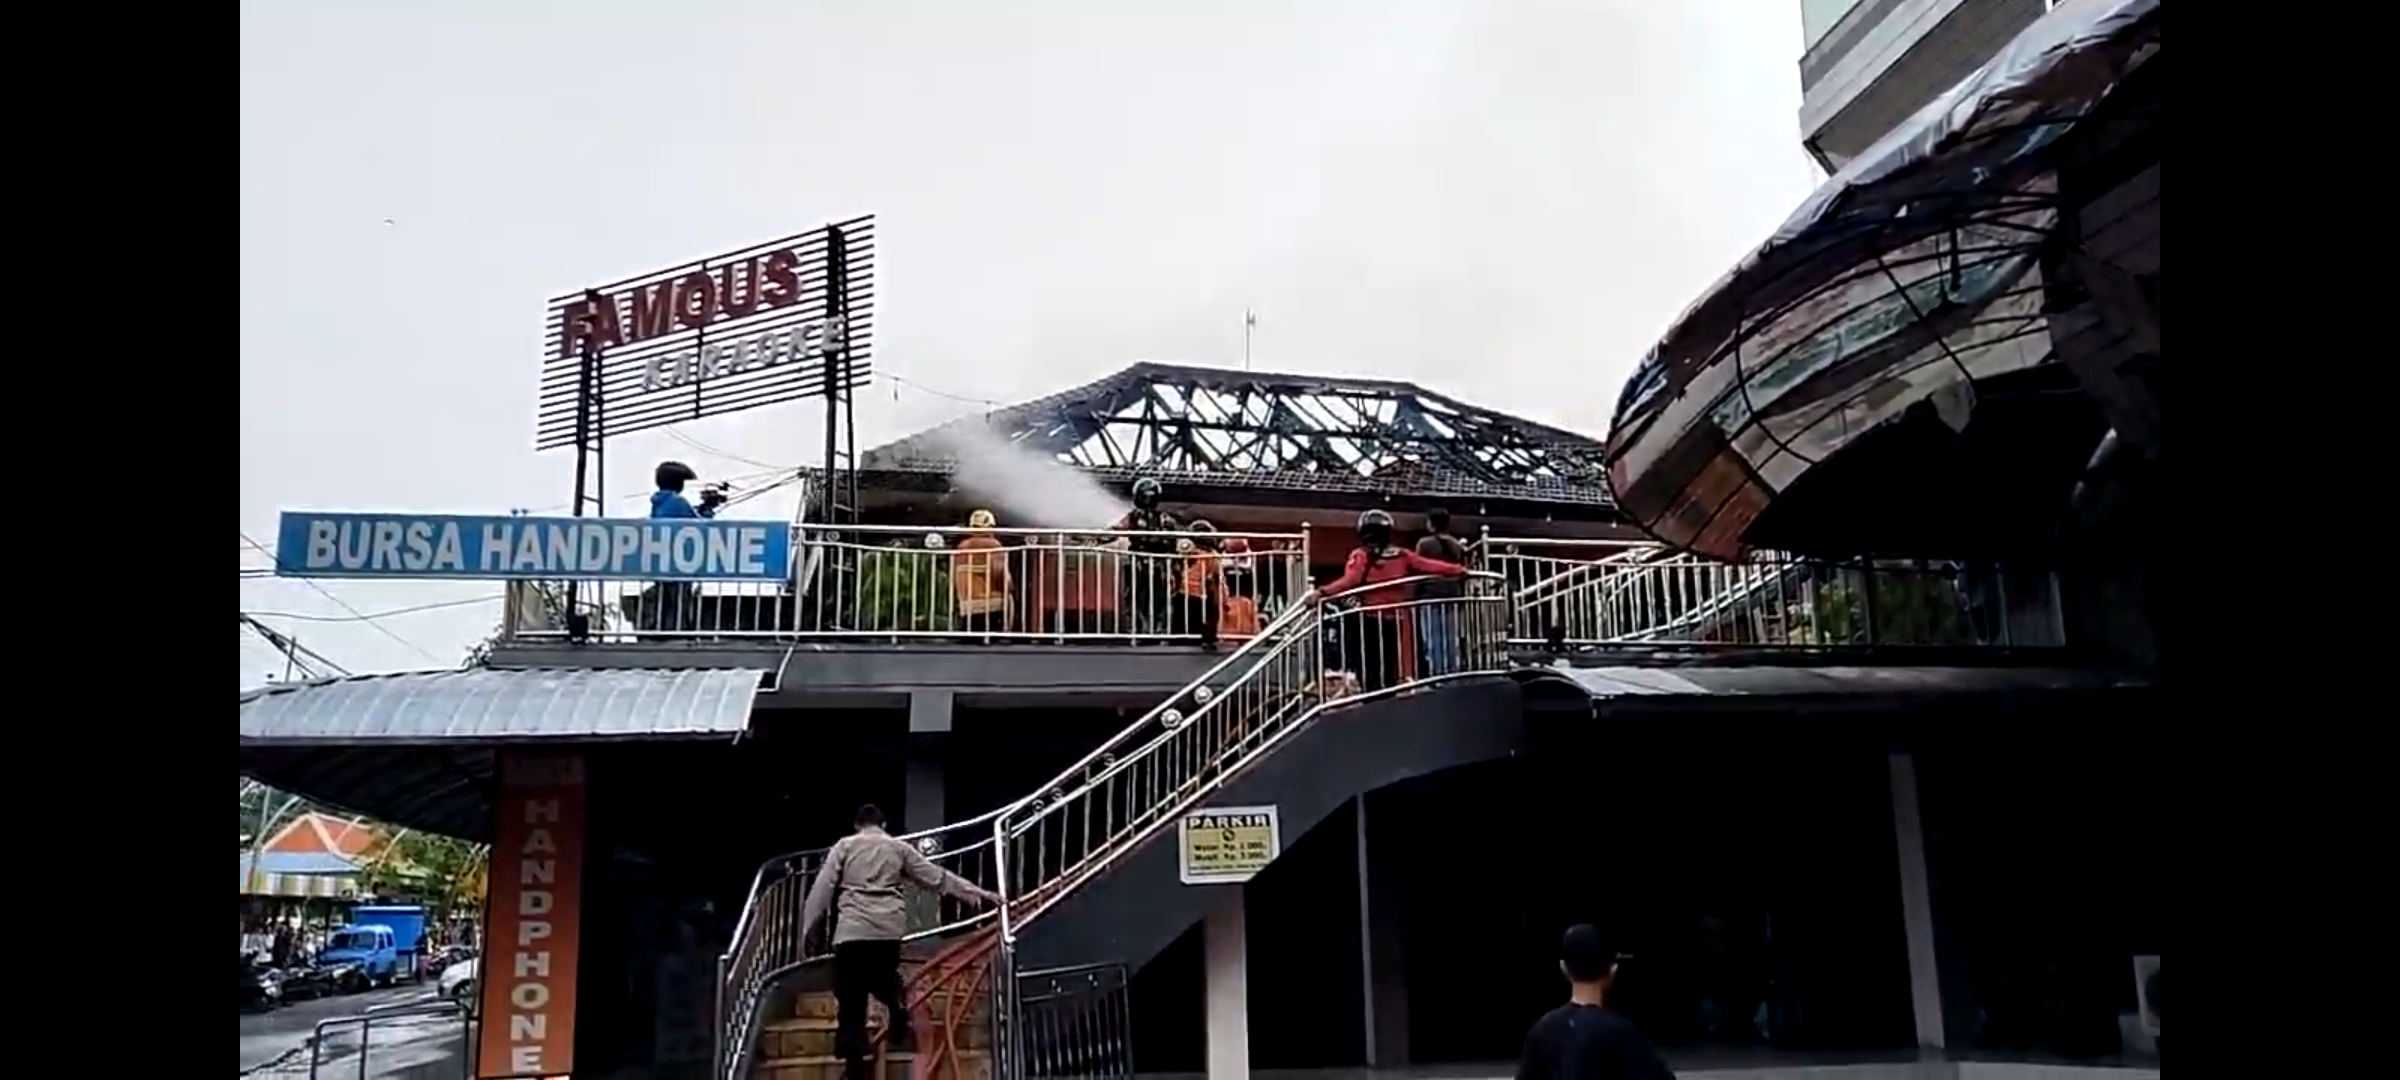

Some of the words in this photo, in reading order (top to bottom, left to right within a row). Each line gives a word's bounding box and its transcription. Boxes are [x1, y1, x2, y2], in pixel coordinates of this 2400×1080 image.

[560, 249, 801, 358] FAMOUS
[641, 315, 845, 393] KARAOKE
[306, 520, 465, 571] BURSA
[480, 522, 766, 574] HANDPHONE
[1189, 814, 1267, 829] PARKIR
[510, 799, 559, 1074] HANDPHONE
